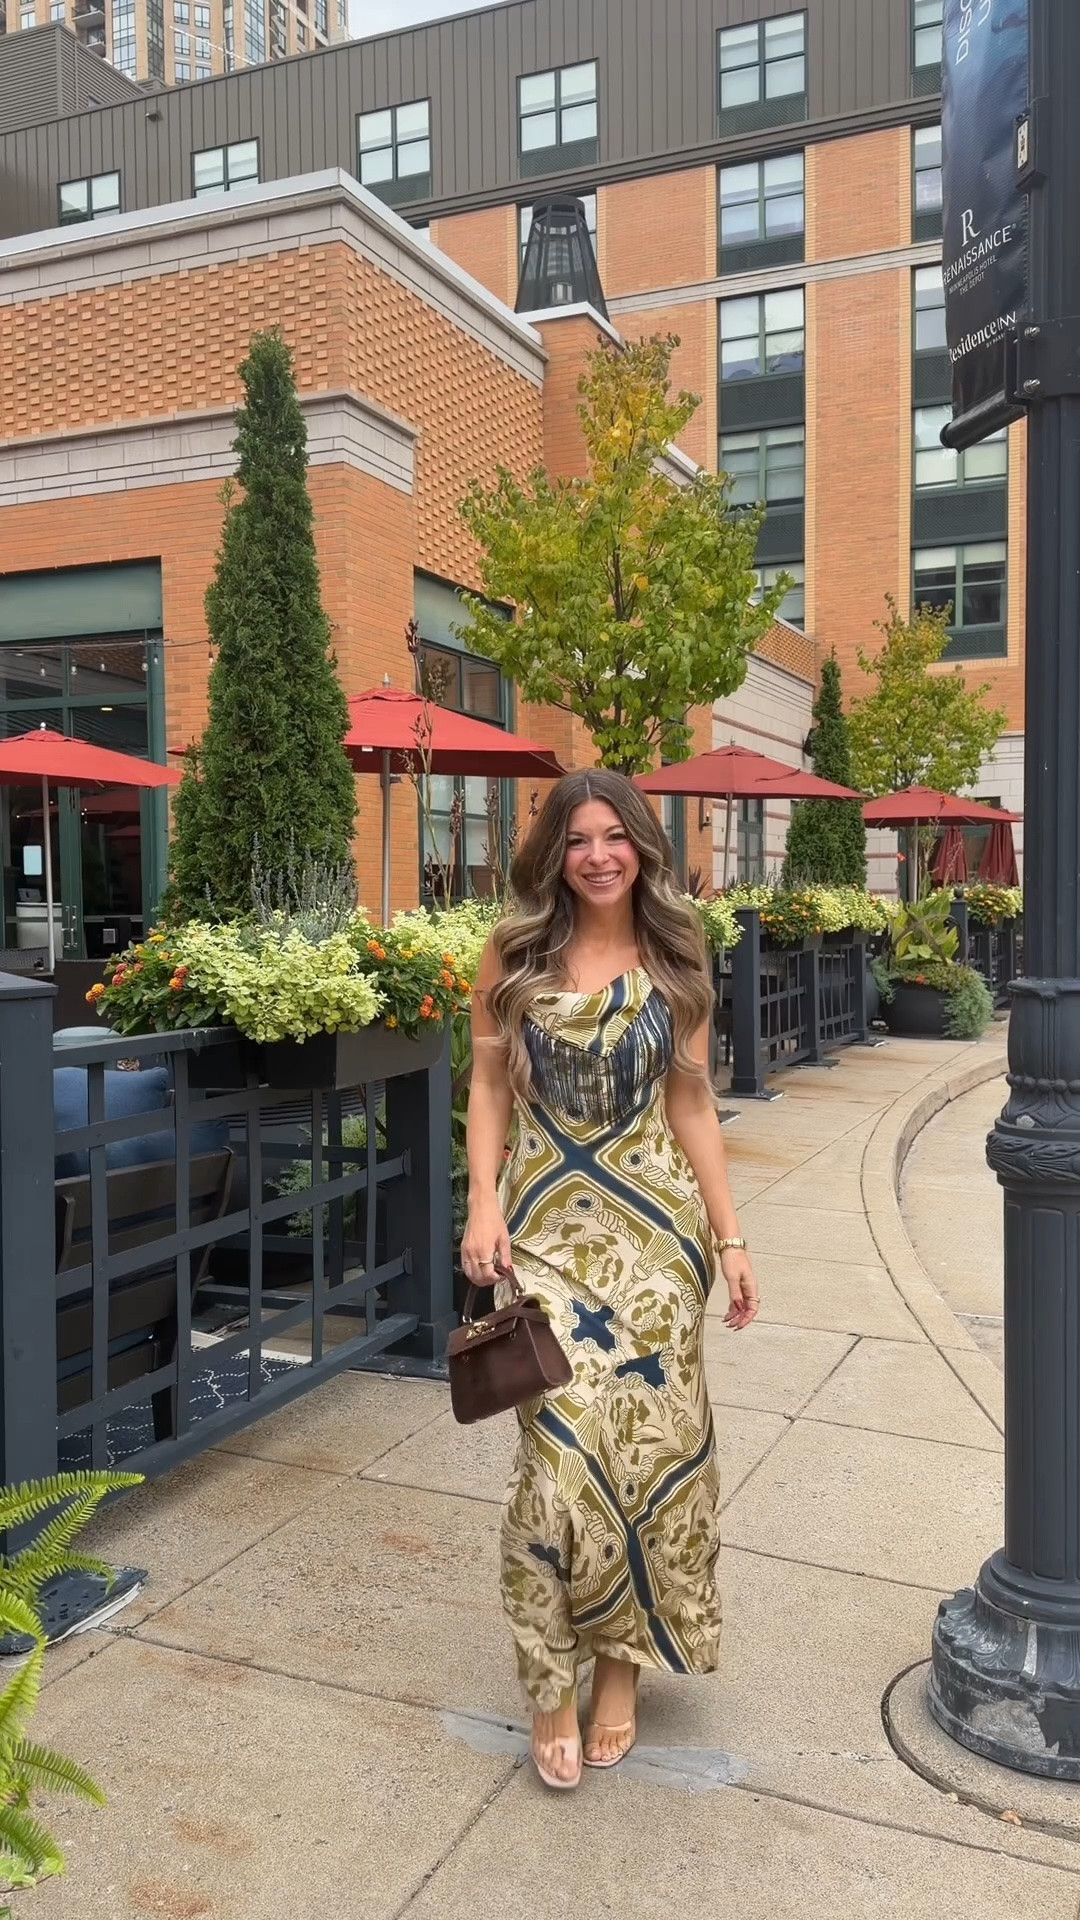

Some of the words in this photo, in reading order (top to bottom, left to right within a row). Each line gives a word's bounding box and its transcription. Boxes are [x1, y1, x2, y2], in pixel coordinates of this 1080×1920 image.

[960, 208, 981, 247] R
[980, 255, 997, 270] HOTEL
[959, 283, 969, 295] THE
[969, 271, 985, 288] DEPOT
